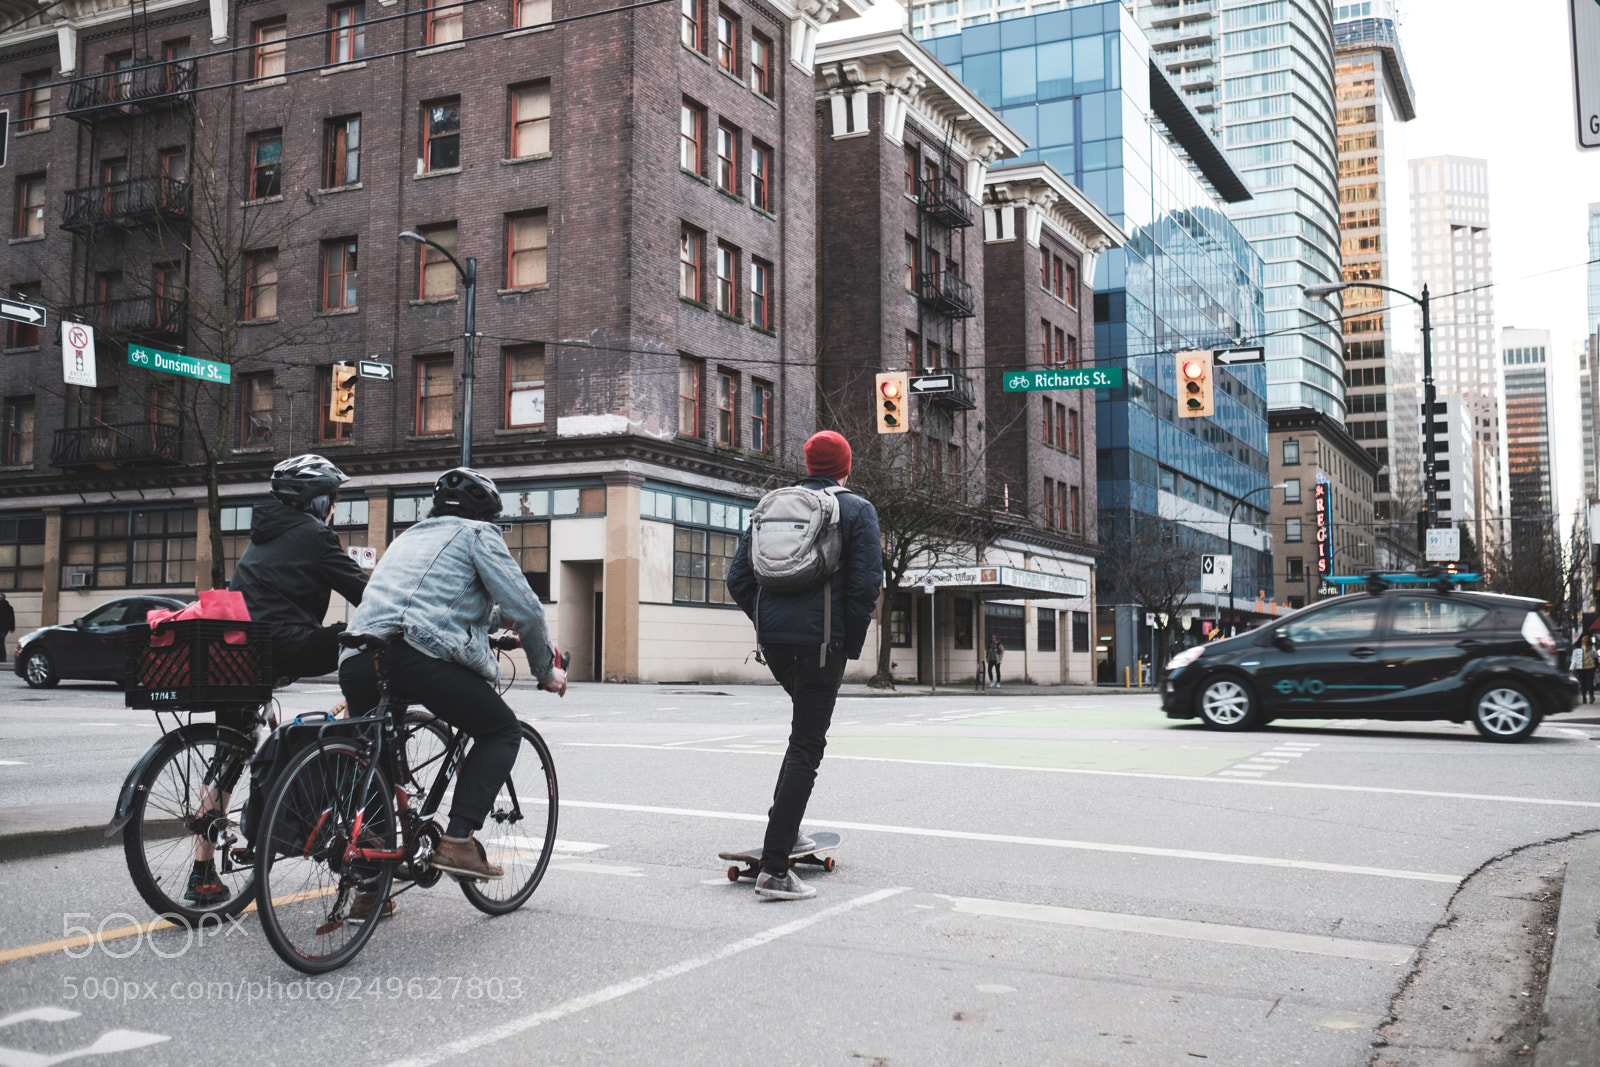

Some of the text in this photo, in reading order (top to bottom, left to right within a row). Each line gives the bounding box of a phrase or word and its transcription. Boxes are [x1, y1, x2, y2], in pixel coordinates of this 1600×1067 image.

[154, 353, 222, 380] Dunsmuir St.
[1035, 371, 1111, 388] Richards St.
[1316, 498, 1326, 572] REGIS
[955, 571, 977, 585] Village
[1012, 570, 1046, 588] STUDENT
[1048, 576, 1078, 594] HOUSING
[1318, 586, 1338, 595] HOTEL
[1275, 678, 1324, 695] evo
